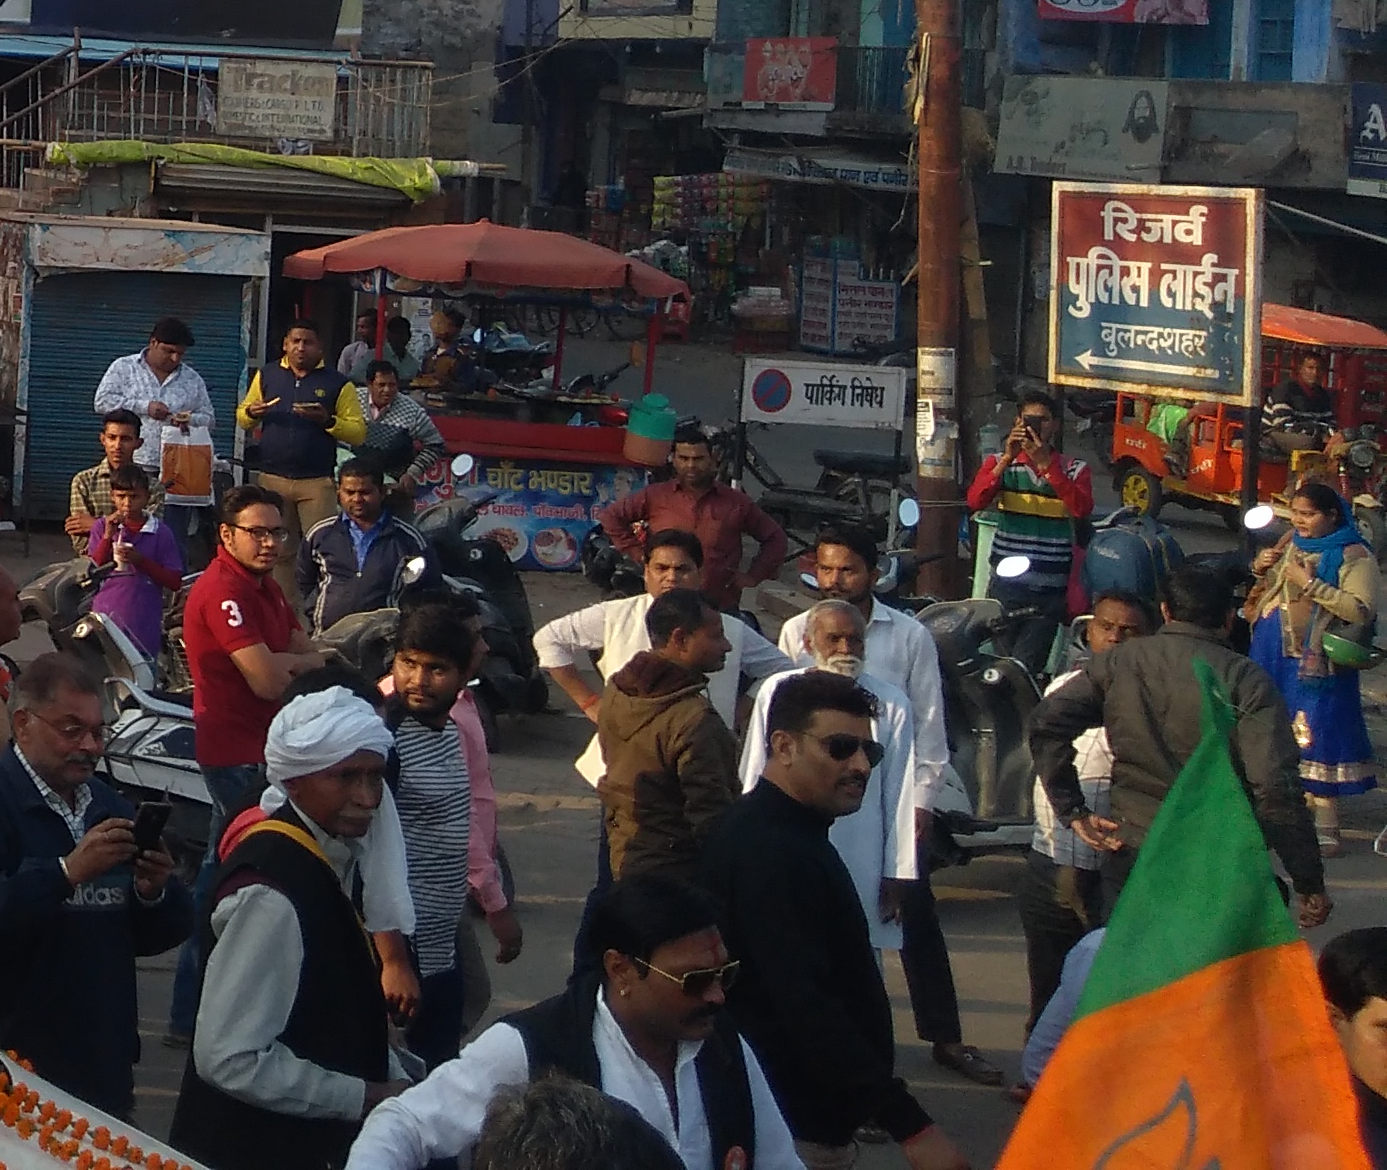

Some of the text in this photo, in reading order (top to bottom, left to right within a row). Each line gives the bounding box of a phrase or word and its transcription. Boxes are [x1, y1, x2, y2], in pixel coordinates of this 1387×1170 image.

[1100, 200, 1208, 246] रिजर्व
[1066, 246, 1240, 319] पुलिस लाईन
[1100, 321, 1210, 357] बुलन्दशहर
[803, 374, 885, 408] पार्किंग निषेध
[528, 469, 593, 495] भण्डार
[221, 600, 244, 627] 3
